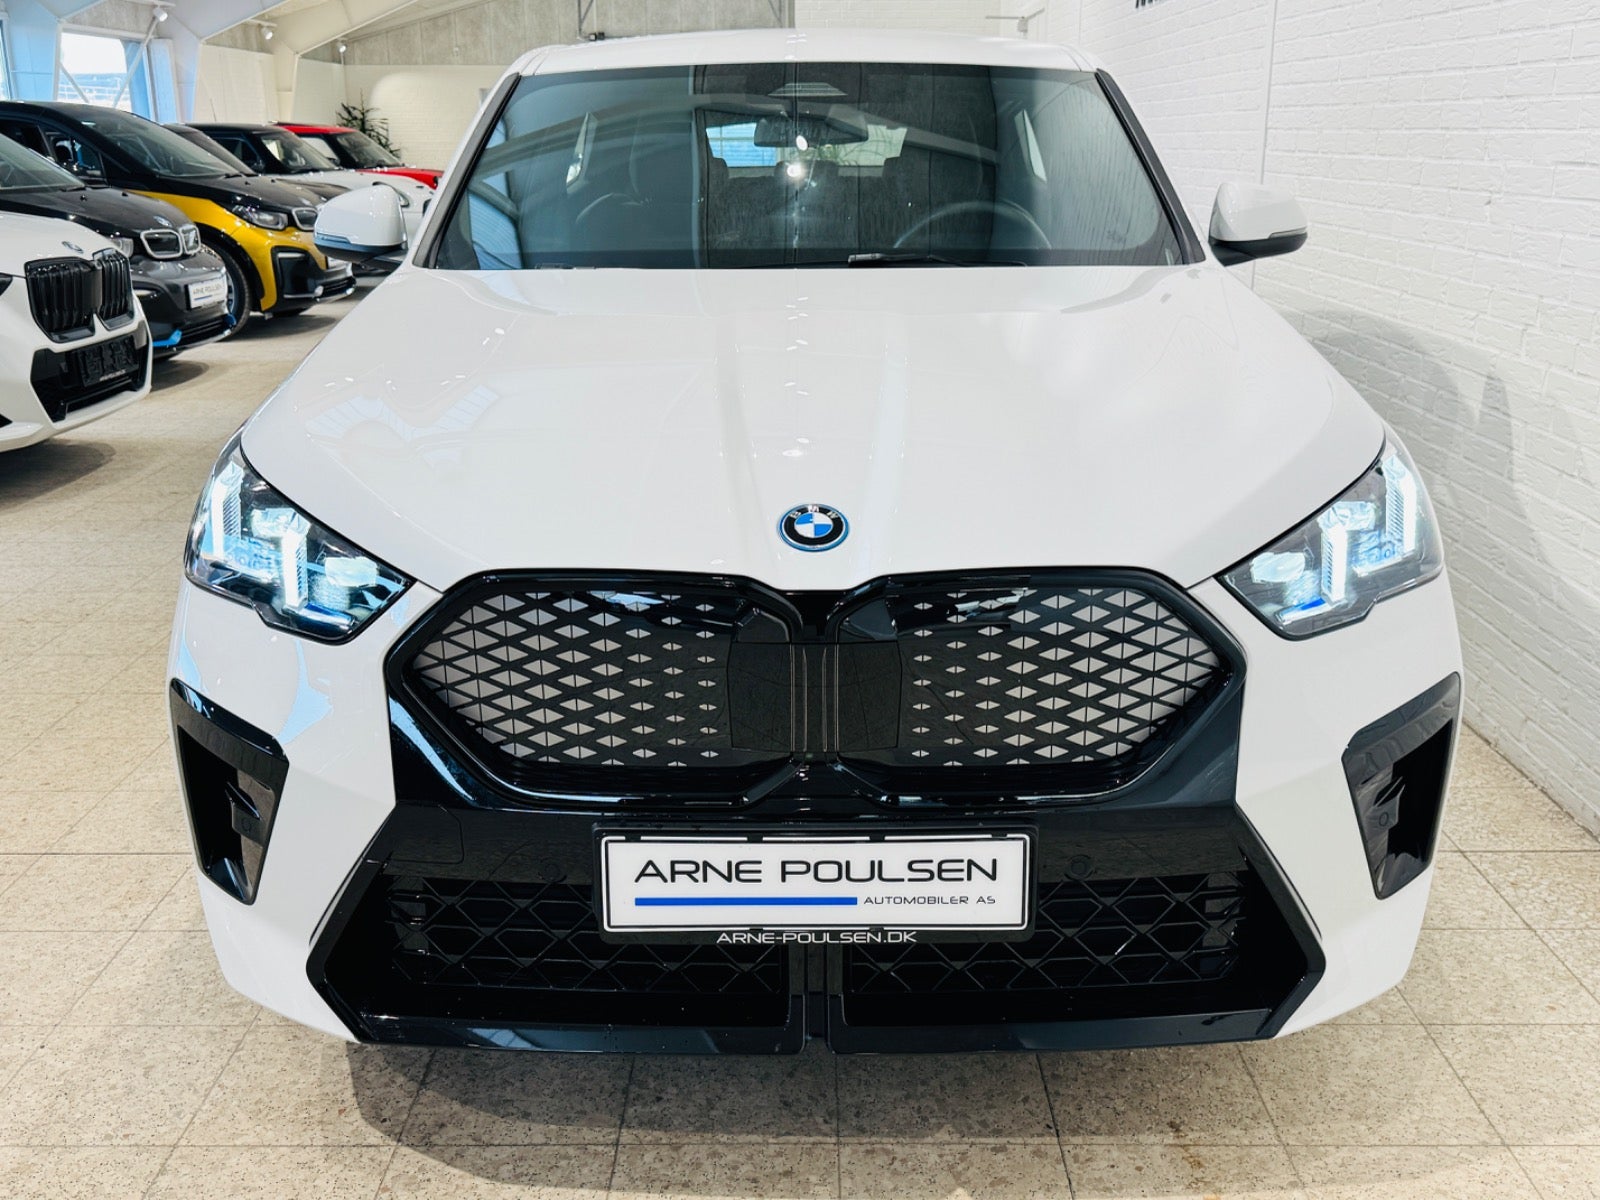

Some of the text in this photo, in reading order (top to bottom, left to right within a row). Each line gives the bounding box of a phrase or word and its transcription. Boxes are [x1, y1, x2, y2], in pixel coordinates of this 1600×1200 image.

[634, 858, 998, 883] ARNE POULSEN
[863, 895, 996, 905] AUTOMOBILER AS
[716, 930, 918, 944] ARNE-POULSEN.DK
